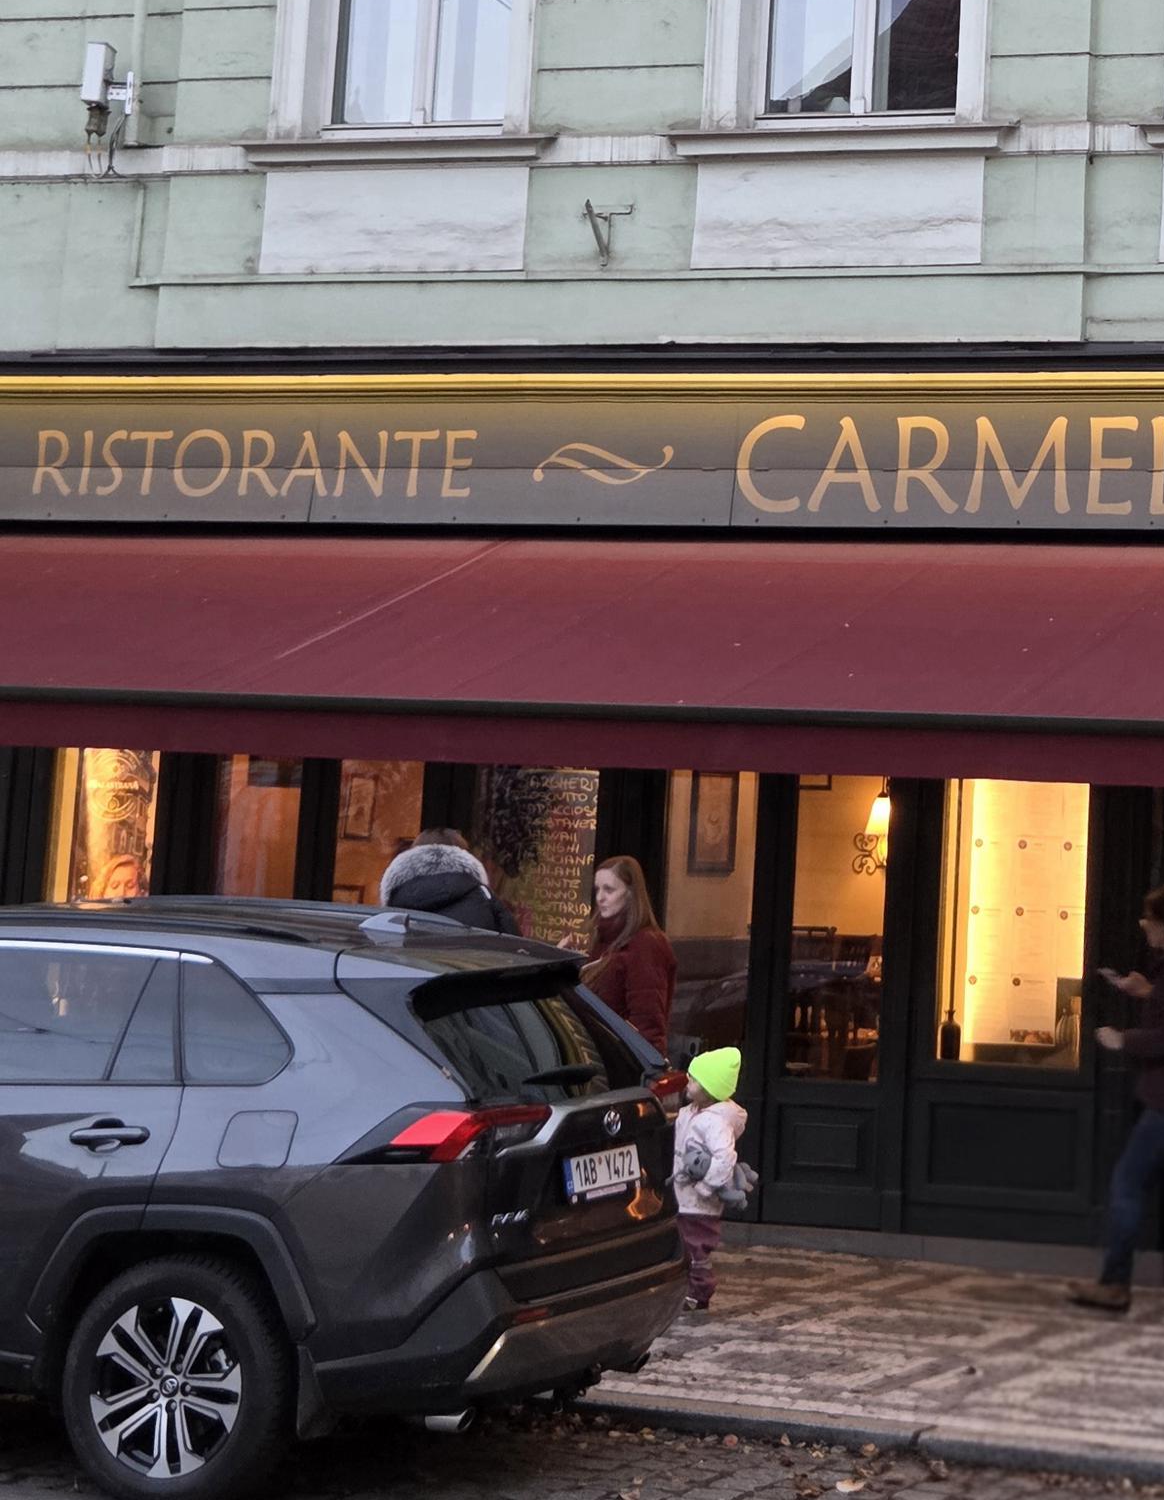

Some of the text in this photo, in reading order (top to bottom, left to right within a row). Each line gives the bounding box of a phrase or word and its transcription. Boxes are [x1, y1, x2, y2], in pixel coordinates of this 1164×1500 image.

[31, 429, 478, 498] RISTORANTE
[575, 1149, 635, 1188] 1AB Y472
